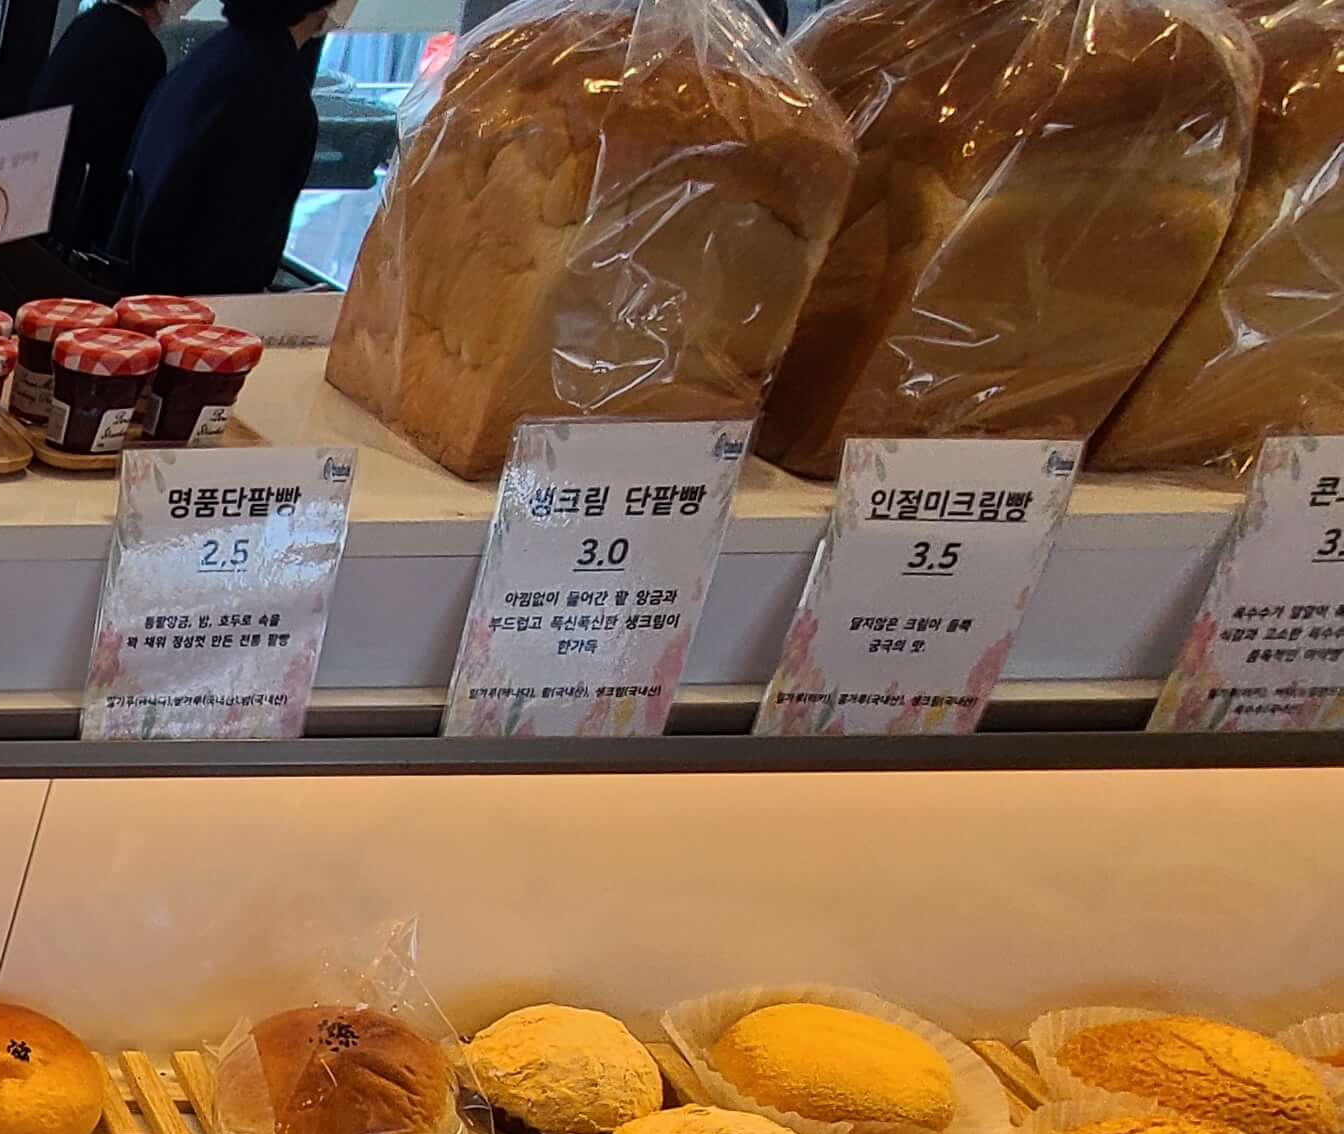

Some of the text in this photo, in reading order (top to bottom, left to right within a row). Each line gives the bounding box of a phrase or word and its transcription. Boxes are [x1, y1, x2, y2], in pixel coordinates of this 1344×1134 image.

[168, 485, 303, 520] 명품단팥빵
[529, 484, 708, 518] 생크림 단팥빵
[869, 488, 1034, 522] 인절미크림빵
[1310, 476, 1344, 507] 콘
[199, 538, 250, 568] 2.5
[577, 537, 630, 567] 3.0
[906, 541, 963, 570] 3.5
[504, 591, 560, 608] 아낌없이
[566, 591, 609, 607] 들어간
[636, 590, 678, 606] 앙금과
[217, 614, 253, 628] 호두로
[488, 615, 542, 632] 부드럽고
[625, 614, 681, 631] 생크림이
[903, 617, 943, 633] 크림이
[144, 635, 168, 649] 채워
[210, 634, 234, 648] 만든
[557, 639, 598, 656] 한가득
